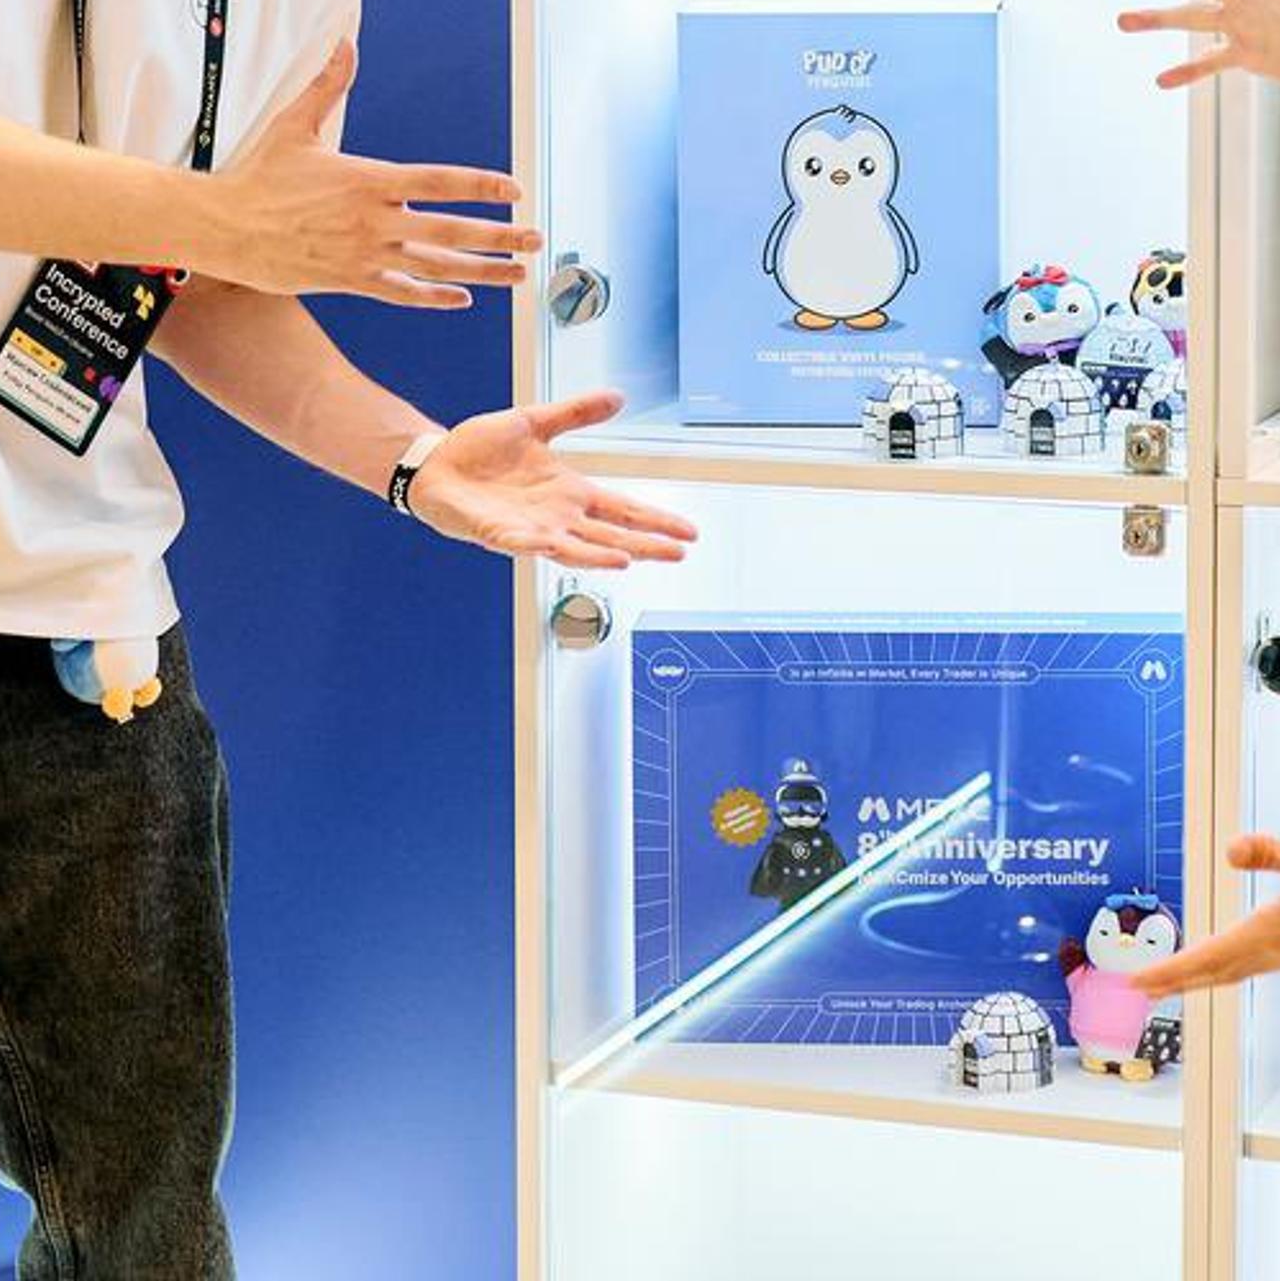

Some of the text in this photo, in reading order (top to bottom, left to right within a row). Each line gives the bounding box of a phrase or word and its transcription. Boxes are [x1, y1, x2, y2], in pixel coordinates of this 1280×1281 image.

[45, 263, 126, 329] Incrypted
[35, 284, 129, 360] Conference
[902, 832, 1110, 867] nniversary
[951, 870, 989, 886] Your
[993, 869, 1110, 889] Opportunities
